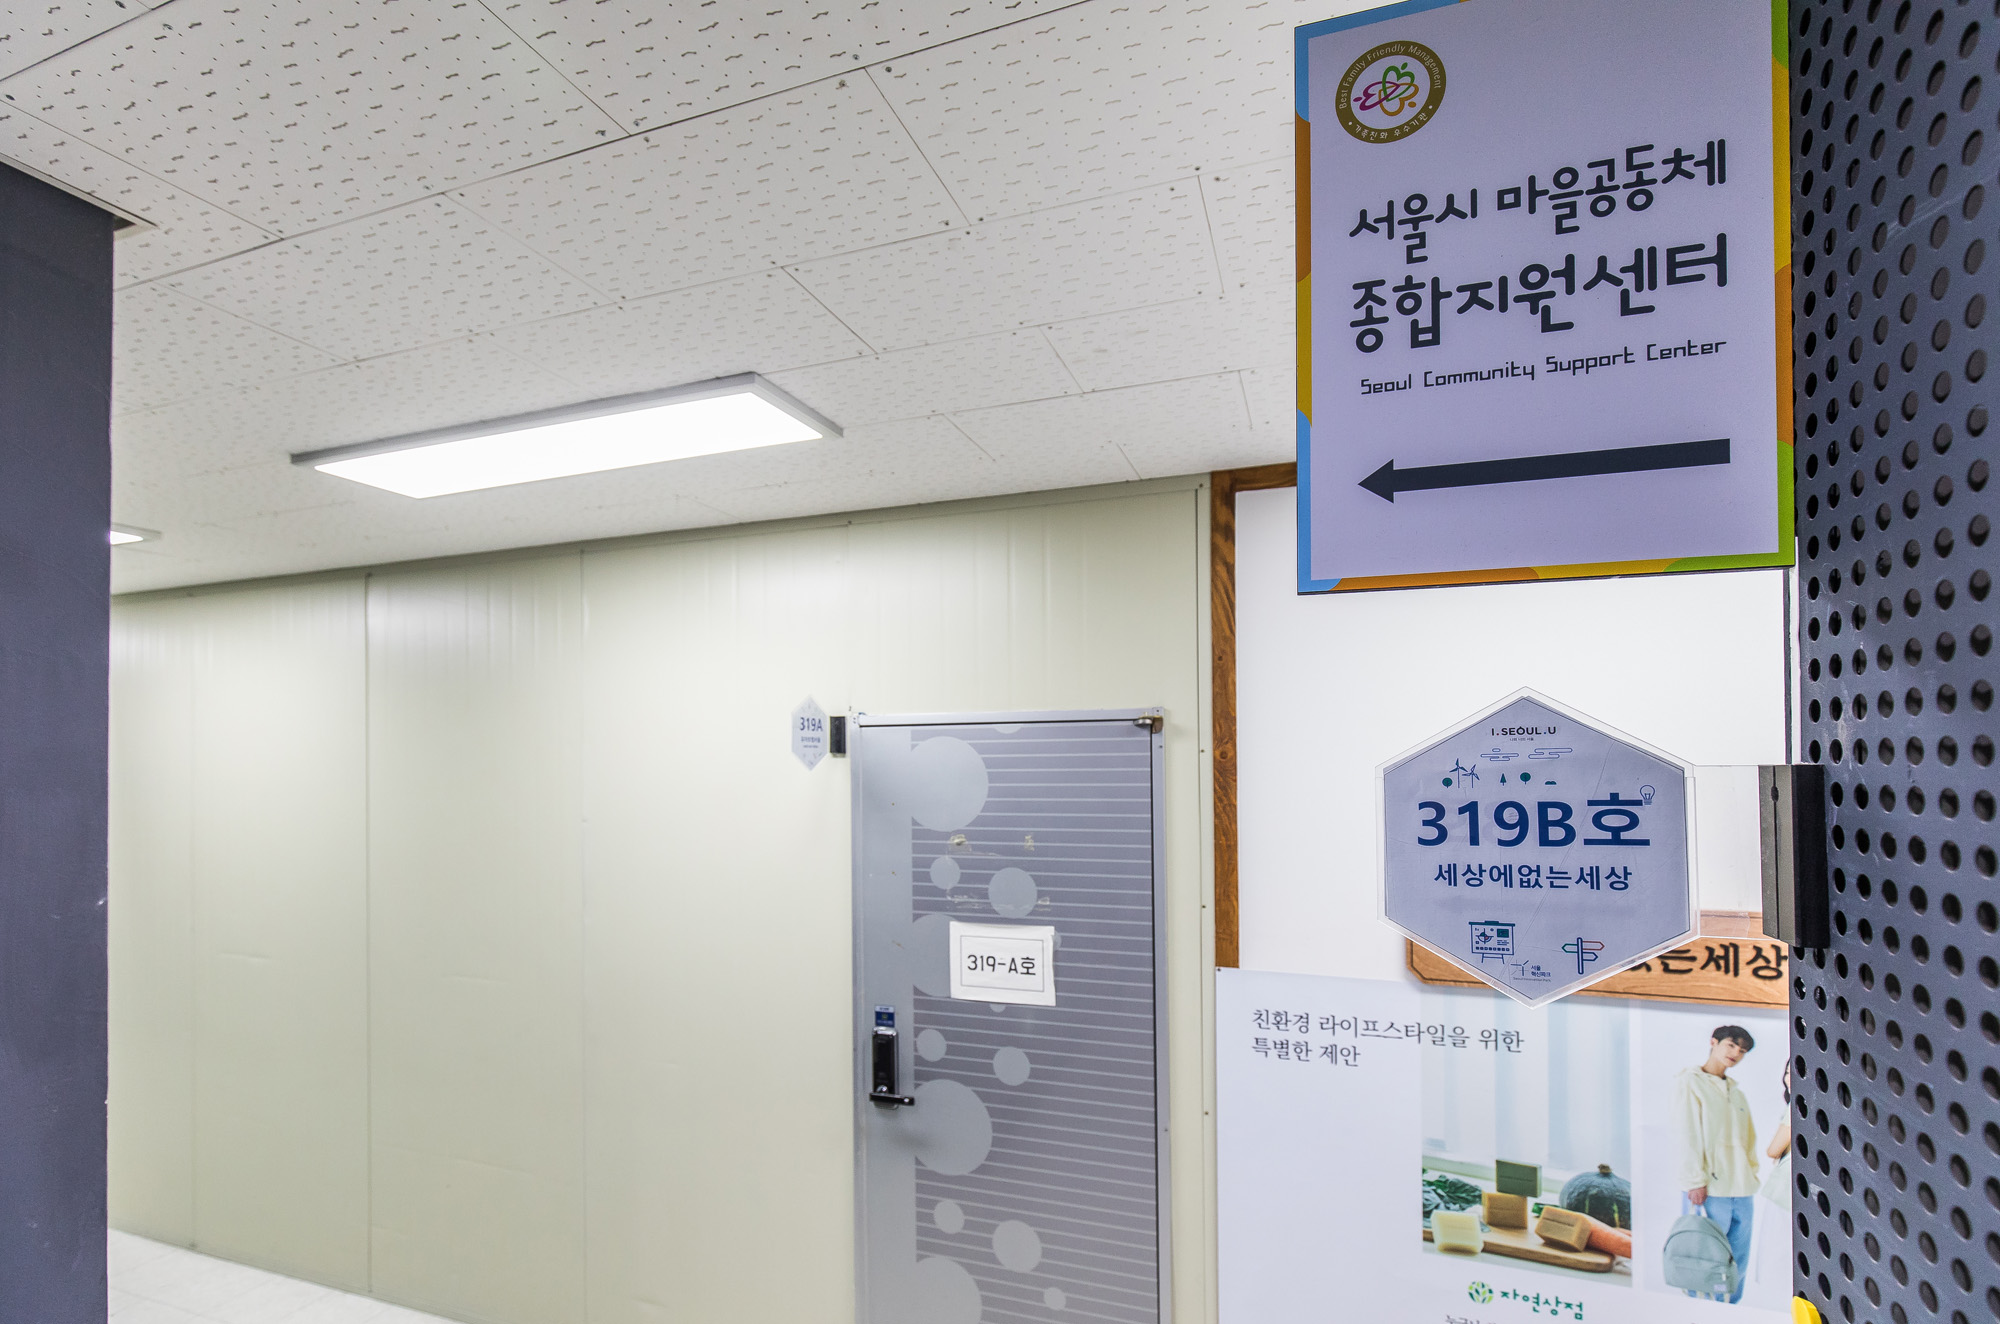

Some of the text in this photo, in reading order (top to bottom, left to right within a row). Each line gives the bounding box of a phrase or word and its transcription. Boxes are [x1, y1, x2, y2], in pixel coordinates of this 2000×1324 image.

[1339, 44, 1442, 109] Best Family Friendly Management
[1349, 139, 1727, 265] 서울시 마을공동체
[1349, 233, 1728, 354] 종합지원센터
[1360, 341, 1727, 395] Seoul Community Support Center
[800, 717, 823, 732] 319A
[1417, 792, 1650, 847] 319B호
[1433, 863, 1633, 891] 세상에없는세상
[967, 954, 1036, 975] 319-A호
[1252, 1009, 1525, 1053] 친환경 라이프스타일을 위한
[1252, 1036, 1361, 1067] 특별한 제안
[1501, 1288, 1583, 1321] 자연상점
